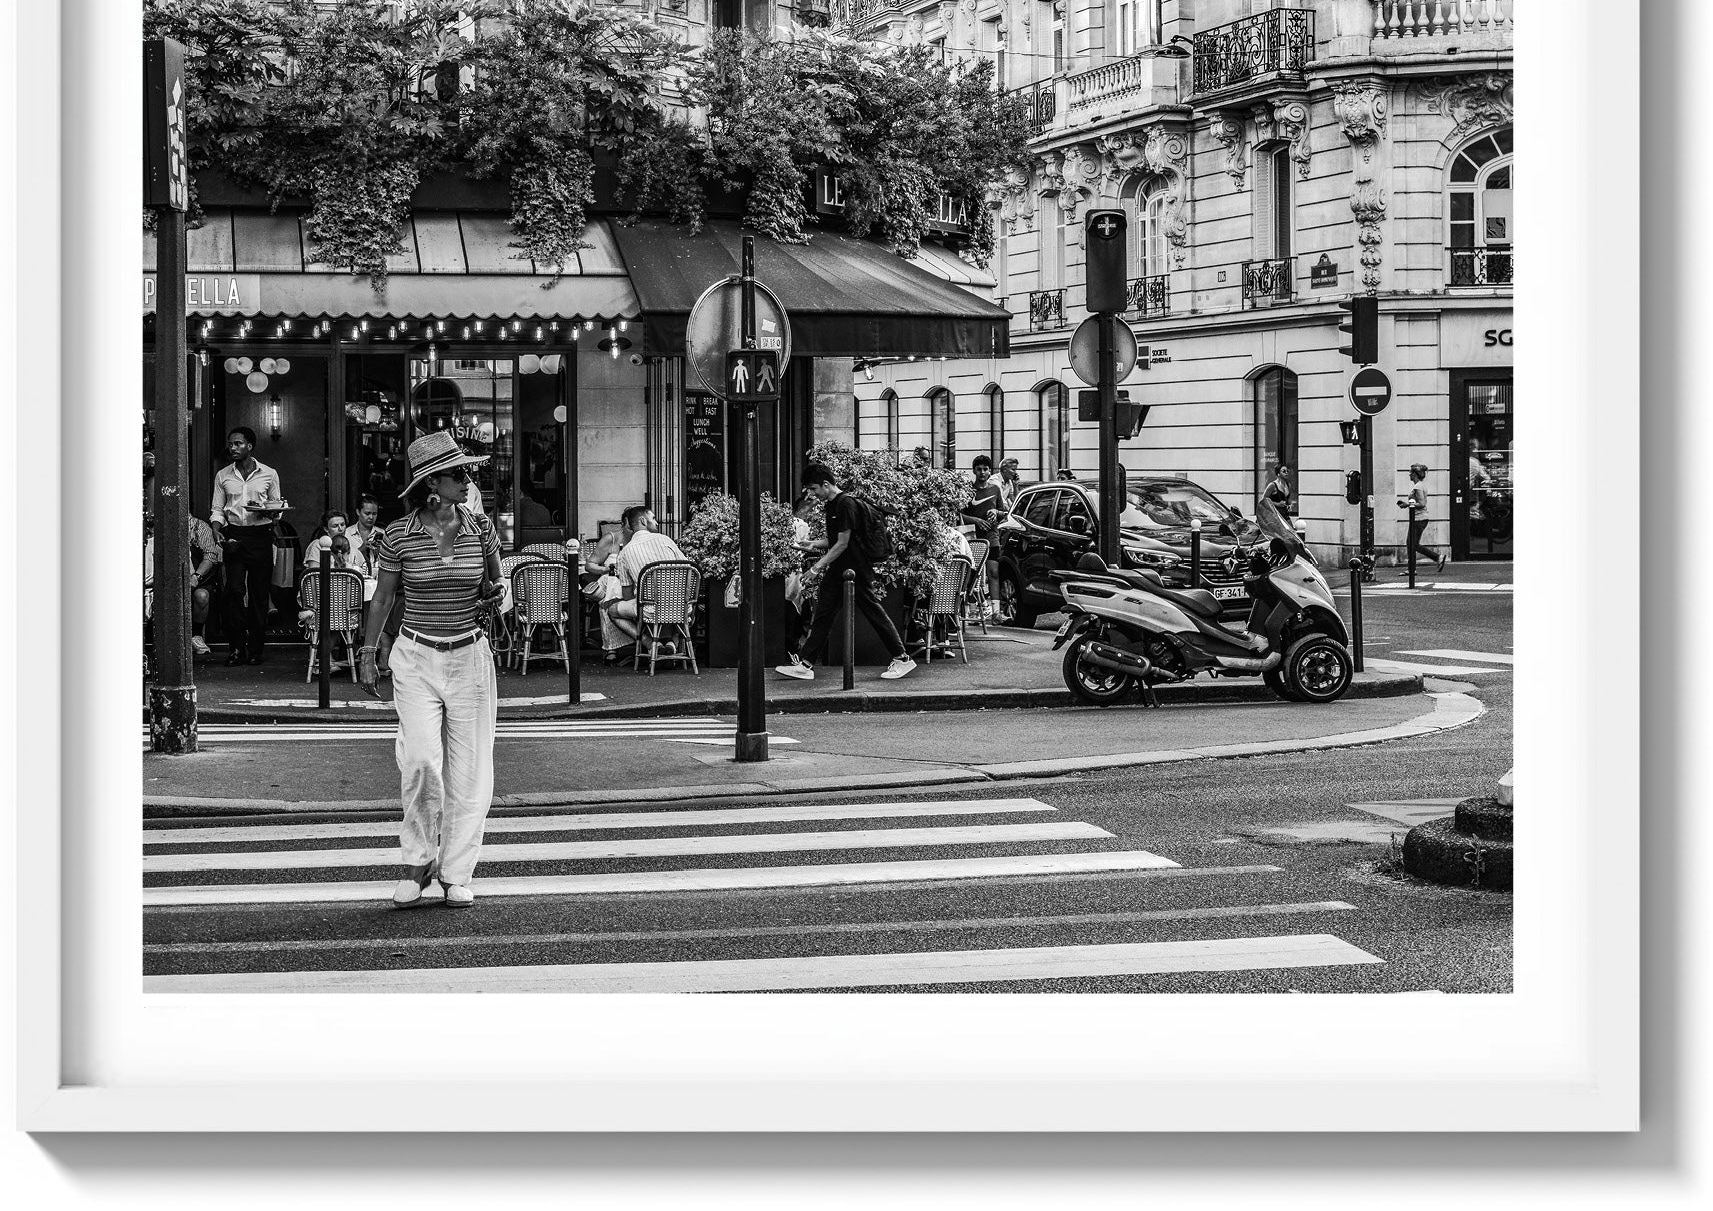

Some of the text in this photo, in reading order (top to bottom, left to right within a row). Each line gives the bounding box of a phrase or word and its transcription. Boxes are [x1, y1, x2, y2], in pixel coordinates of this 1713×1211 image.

[1484, 329, 1514, 347] SG
[702, 396, 718, 406] BREAK
[704, 407, 717, 416] FAST
[692, 418, 710, 427] LUNCH
[693, 427, 708, 436] WELL
